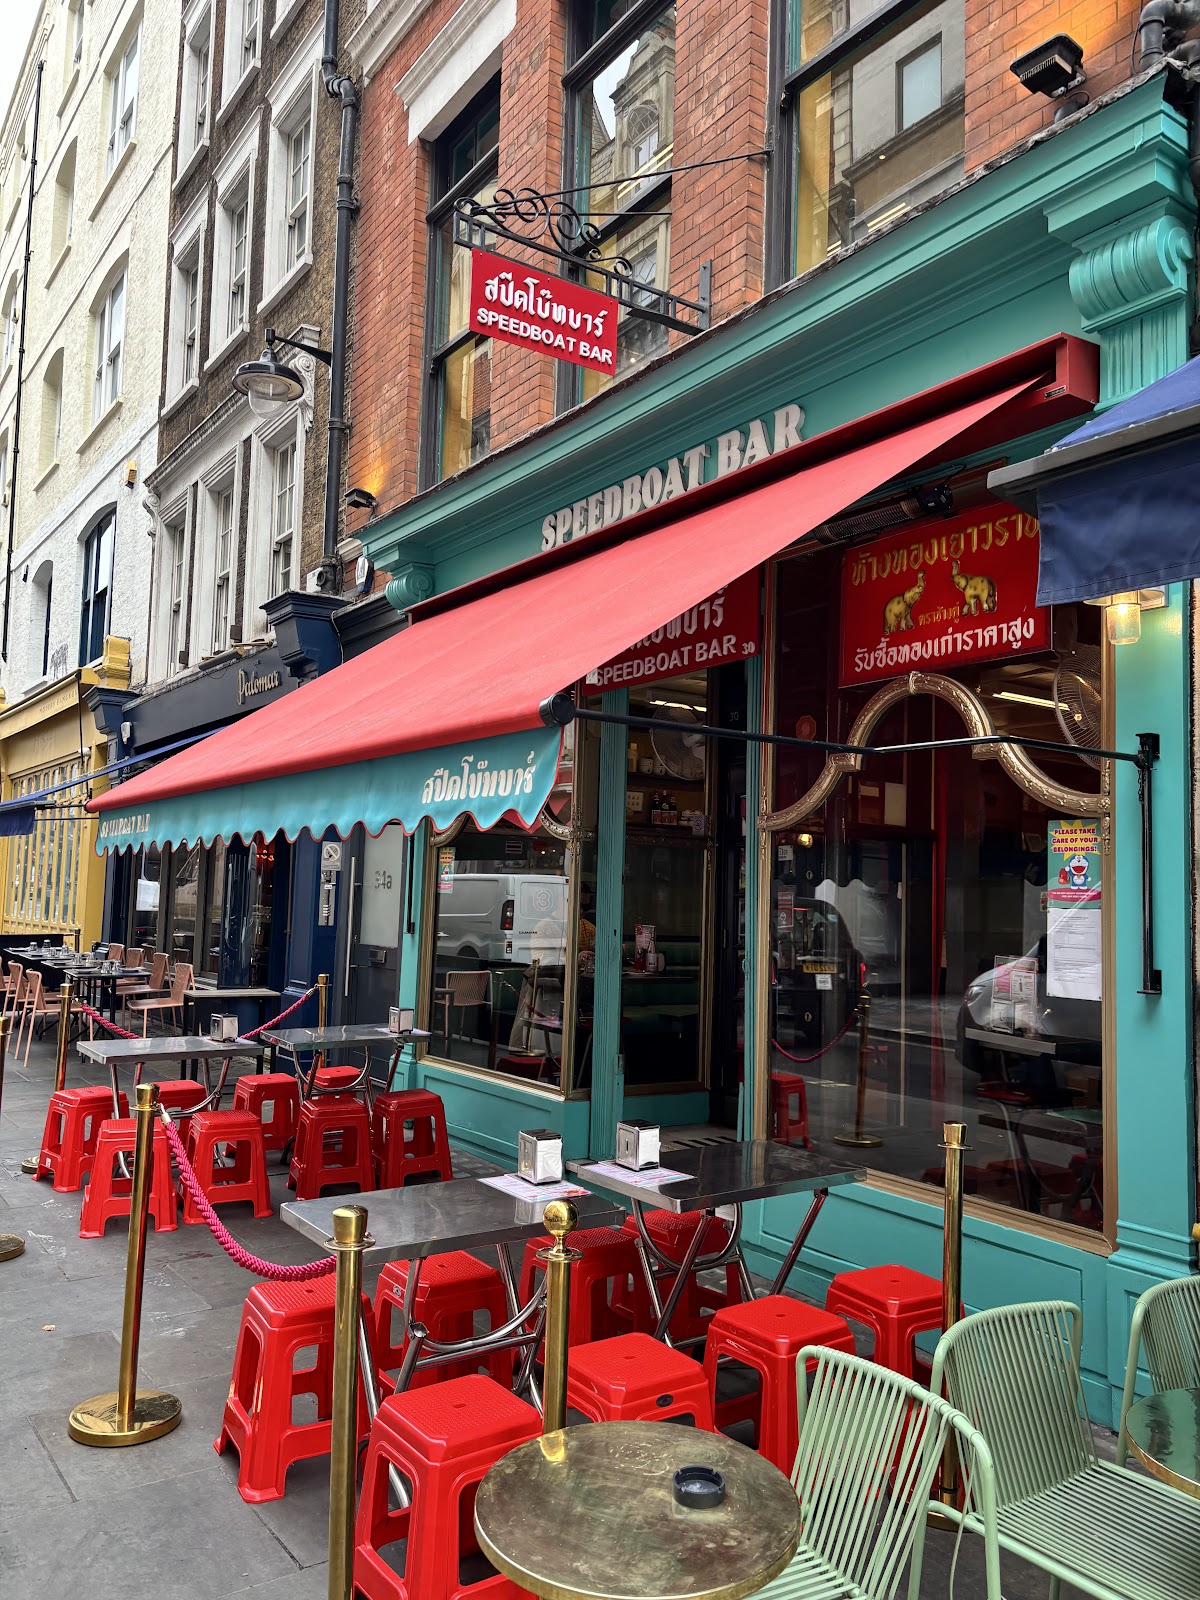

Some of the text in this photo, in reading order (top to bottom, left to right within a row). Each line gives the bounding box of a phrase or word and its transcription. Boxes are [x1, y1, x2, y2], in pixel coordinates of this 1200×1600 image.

[476, 307, 613, 365] SPEEDBOAT BAR
[541, 403, 806, 552] SPEEDBOAT BAR
[595, 634, 737, 687] SPEEDBOAT BAR
[742, 641, 756, 655] 30
[237, 668, 279, 705] Palomar
